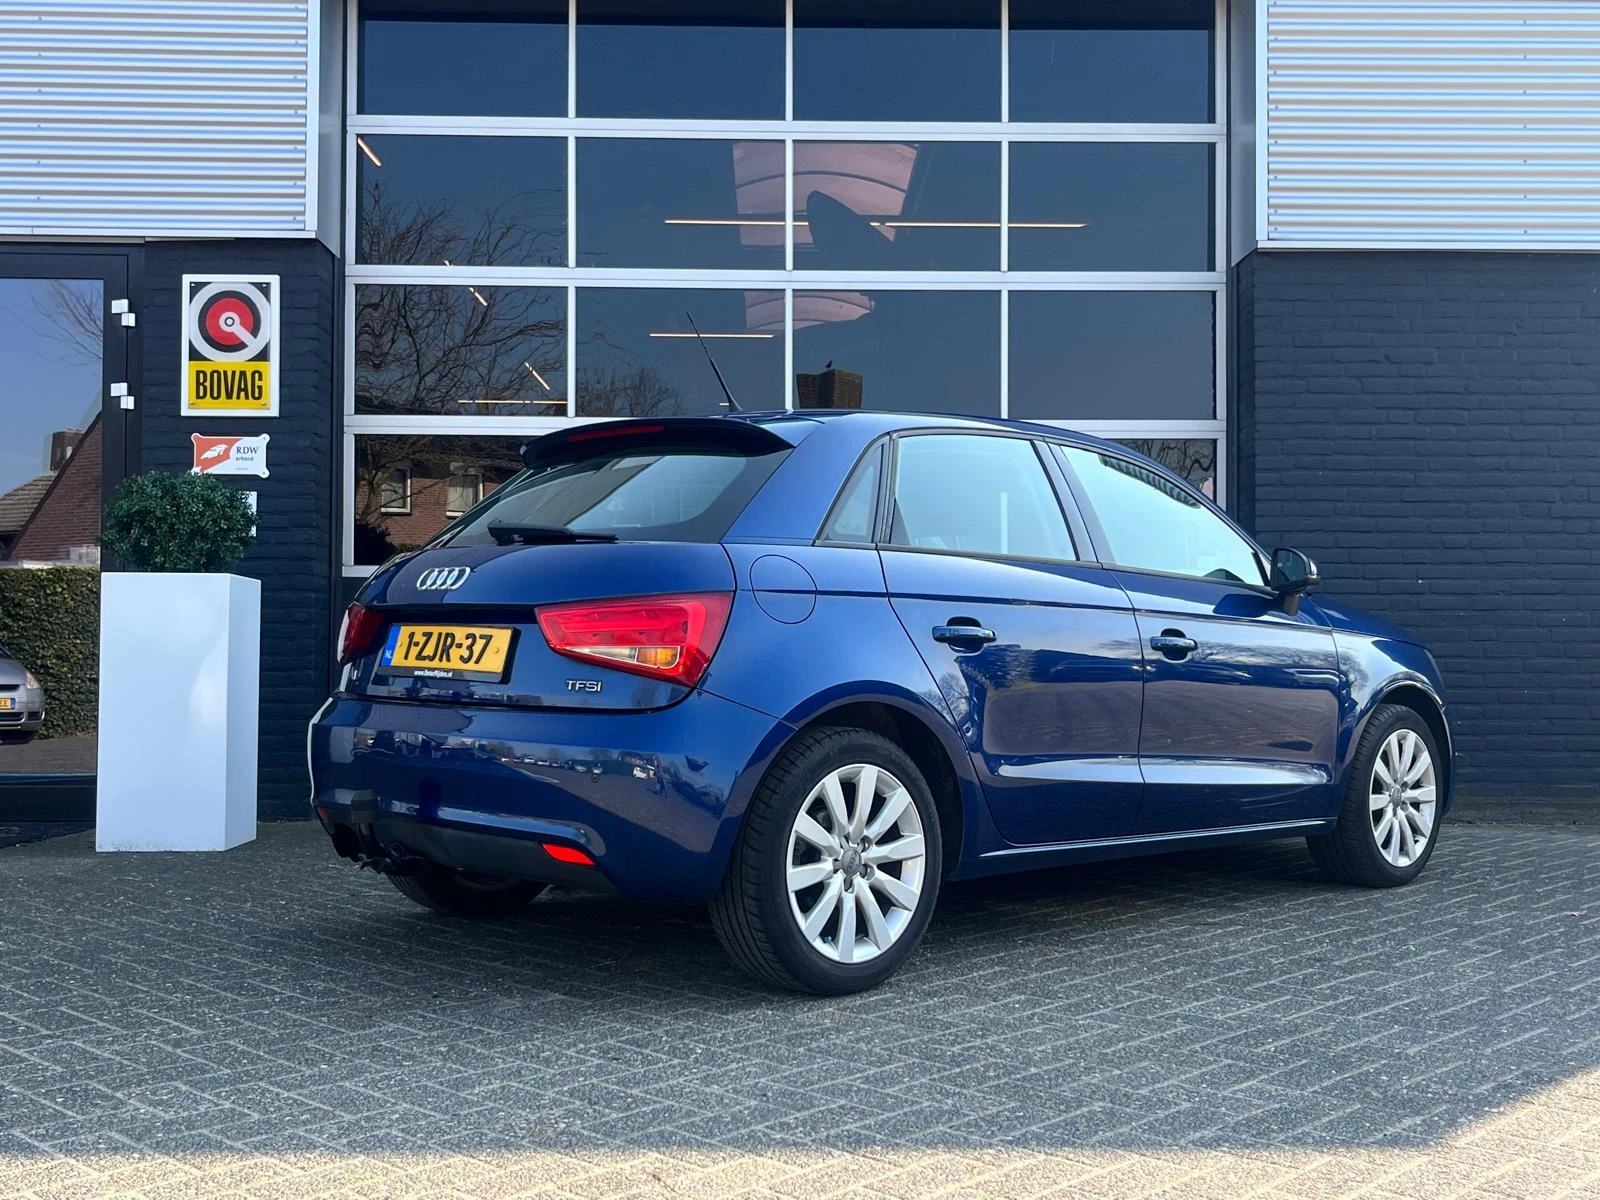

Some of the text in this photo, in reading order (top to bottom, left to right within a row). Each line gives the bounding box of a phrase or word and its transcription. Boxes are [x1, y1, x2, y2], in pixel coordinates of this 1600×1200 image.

[195, 369, 264, 400] BOVAG
[236, 446, 259, 454] RDW
[403, 631, 493, 665] 1-ZJR-37
[565, 679, 602, 692] TFSI
